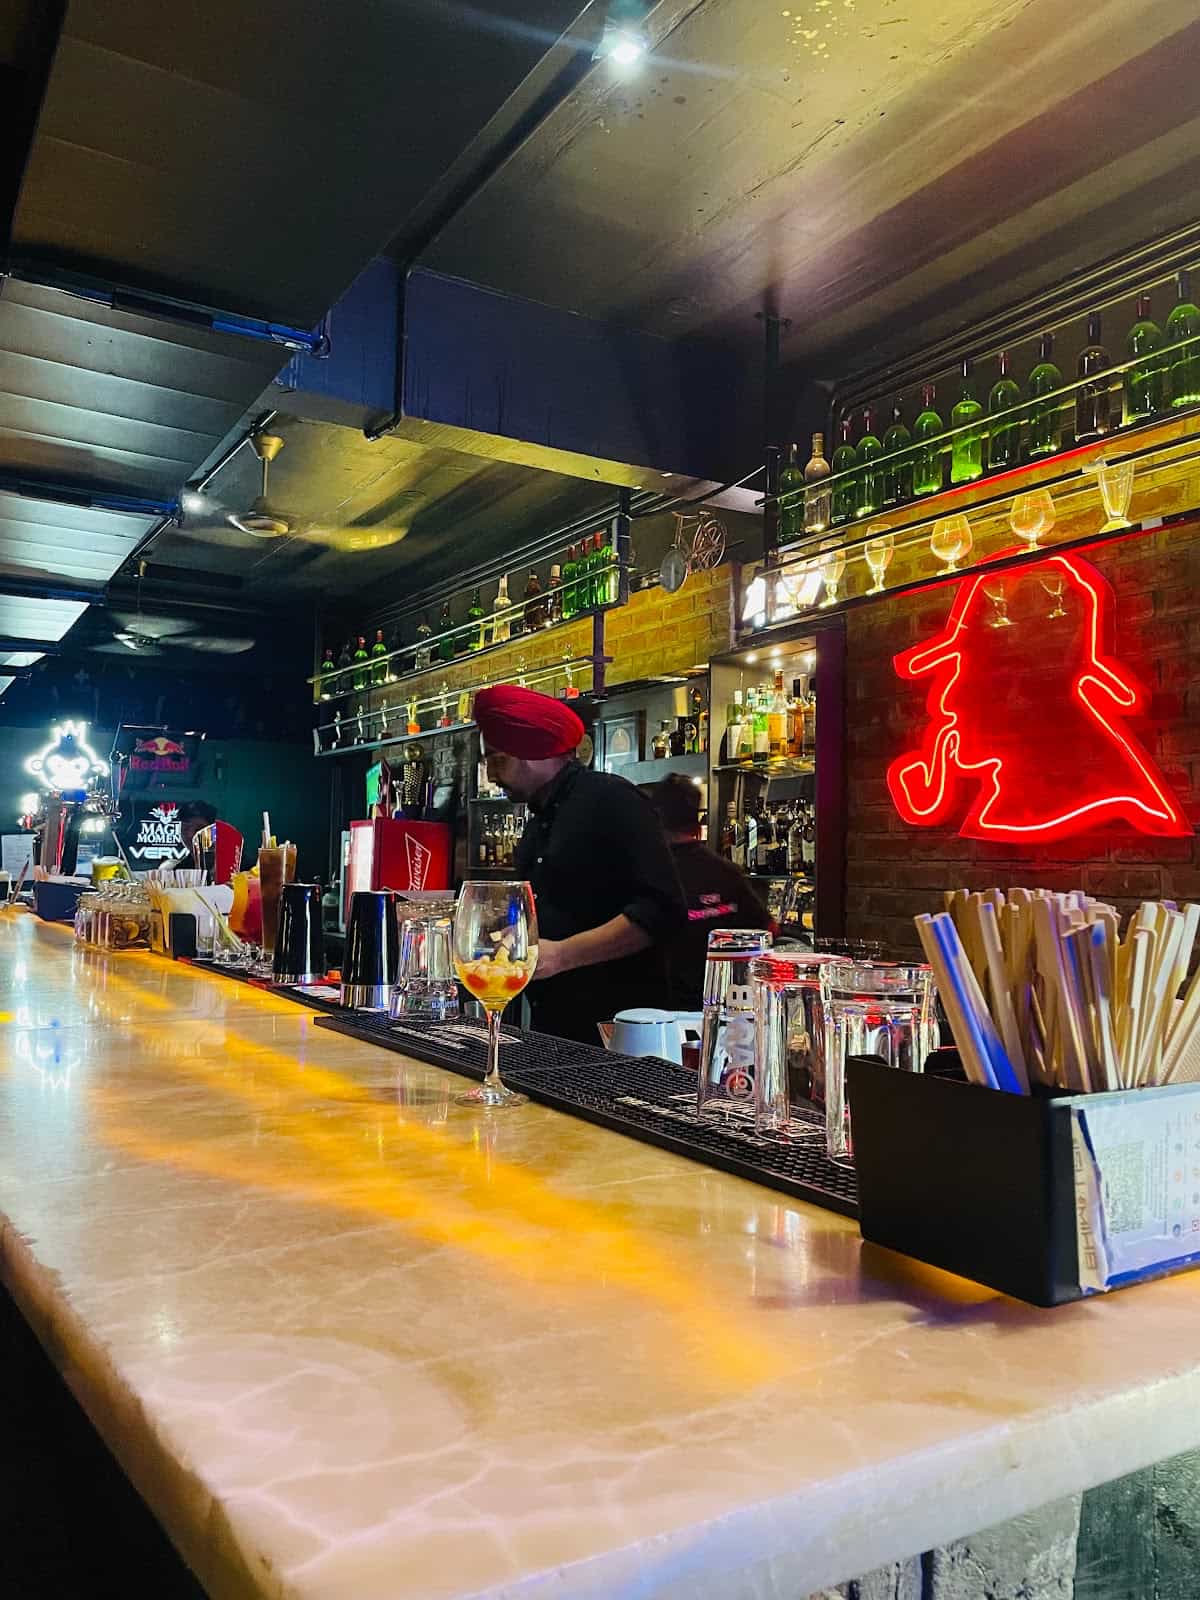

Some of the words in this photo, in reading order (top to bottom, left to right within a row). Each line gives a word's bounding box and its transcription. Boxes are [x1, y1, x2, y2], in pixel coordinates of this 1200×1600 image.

[140, 822, 182, 835] MAGI
[136, 833, 182, 844] MOMEN
[410, 842, 423, 891] dweiser
